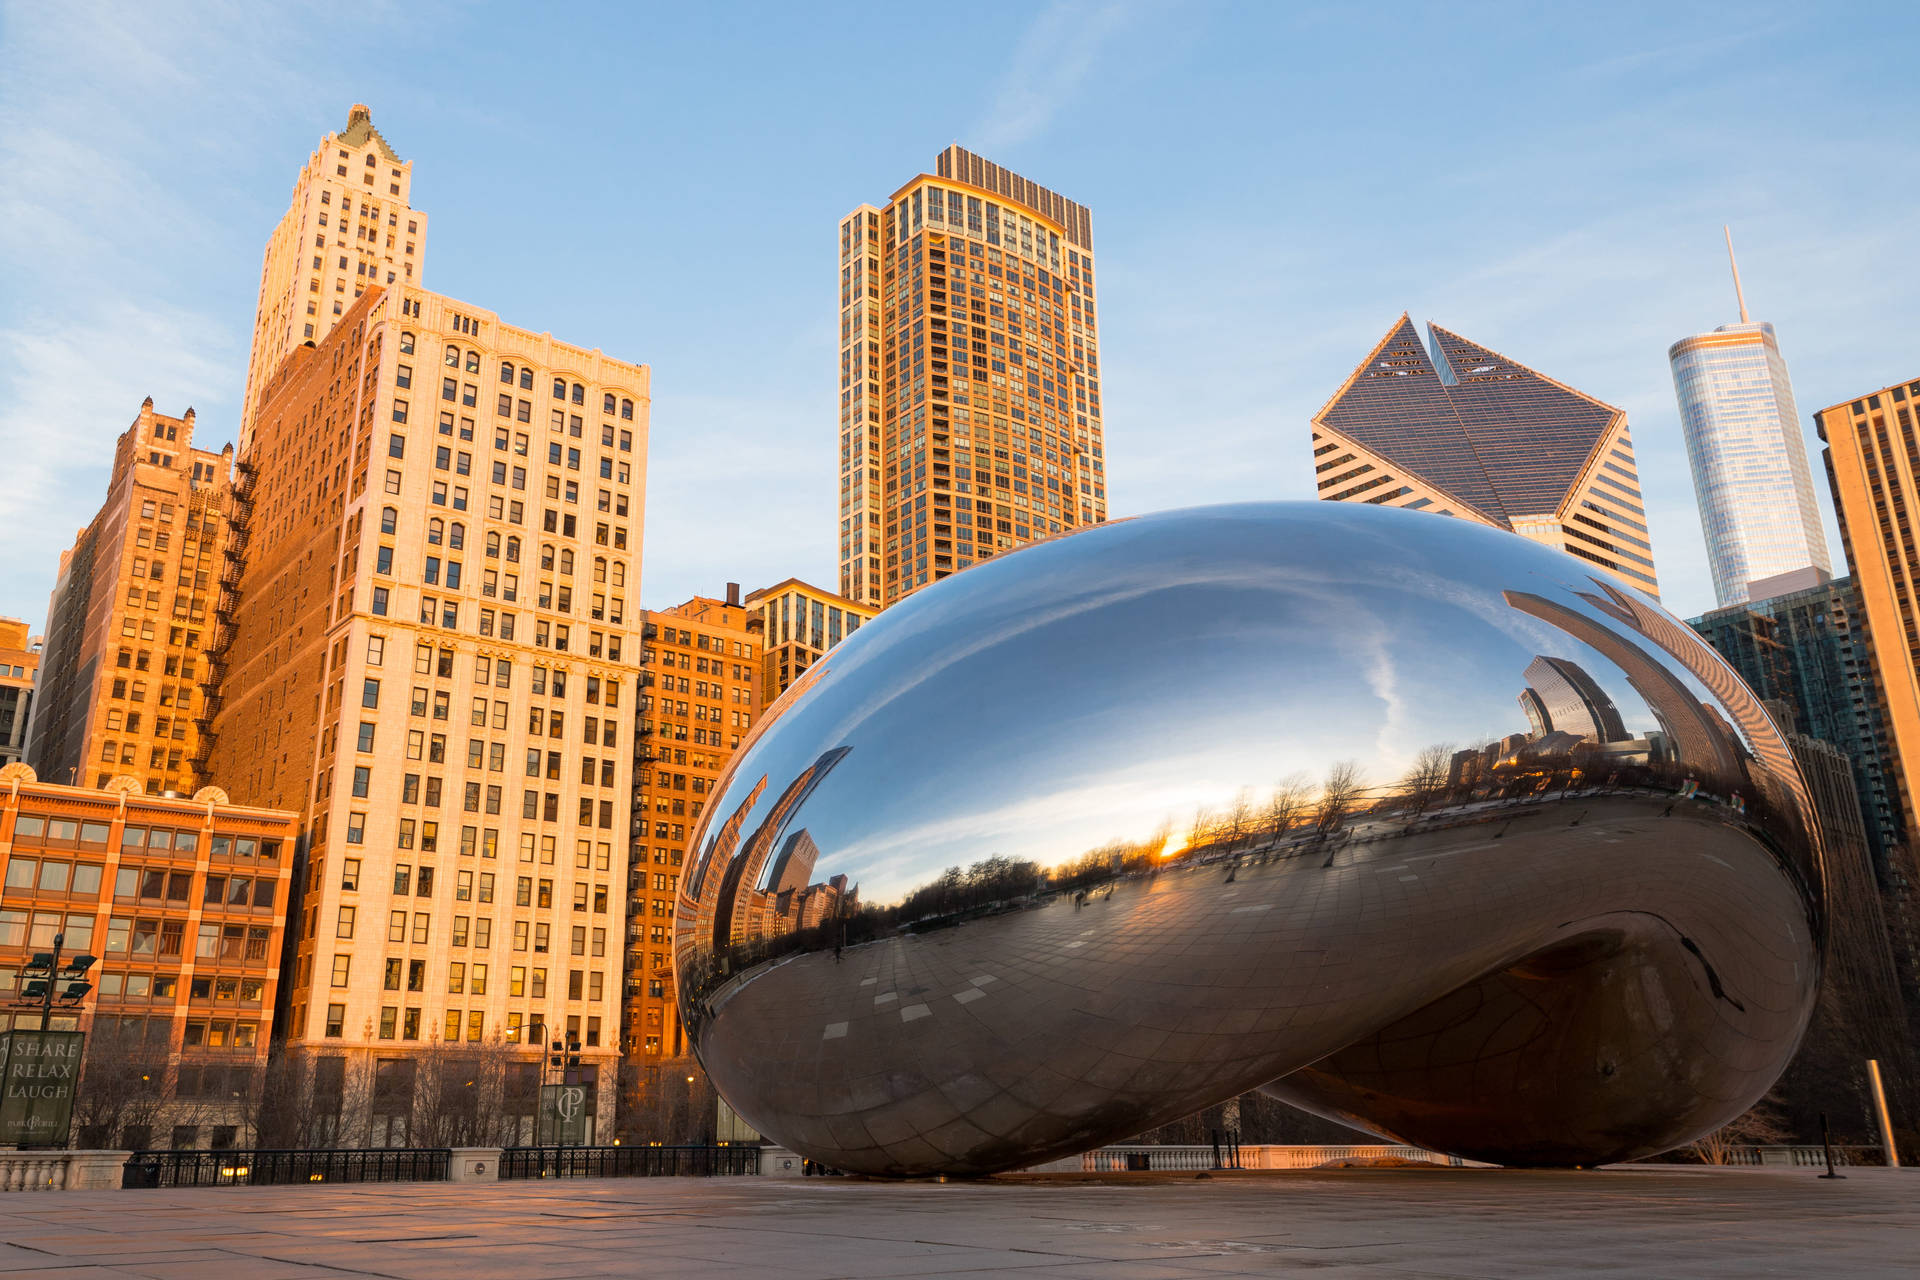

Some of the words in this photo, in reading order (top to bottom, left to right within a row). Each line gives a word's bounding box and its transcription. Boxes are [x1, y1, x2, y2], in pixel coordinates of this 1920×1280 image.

[15, 1042, 77, 1057] SHARE
[13, 1063, 72, 1079] RELAX
[8, 1085, 69, 1099] LAUGH
